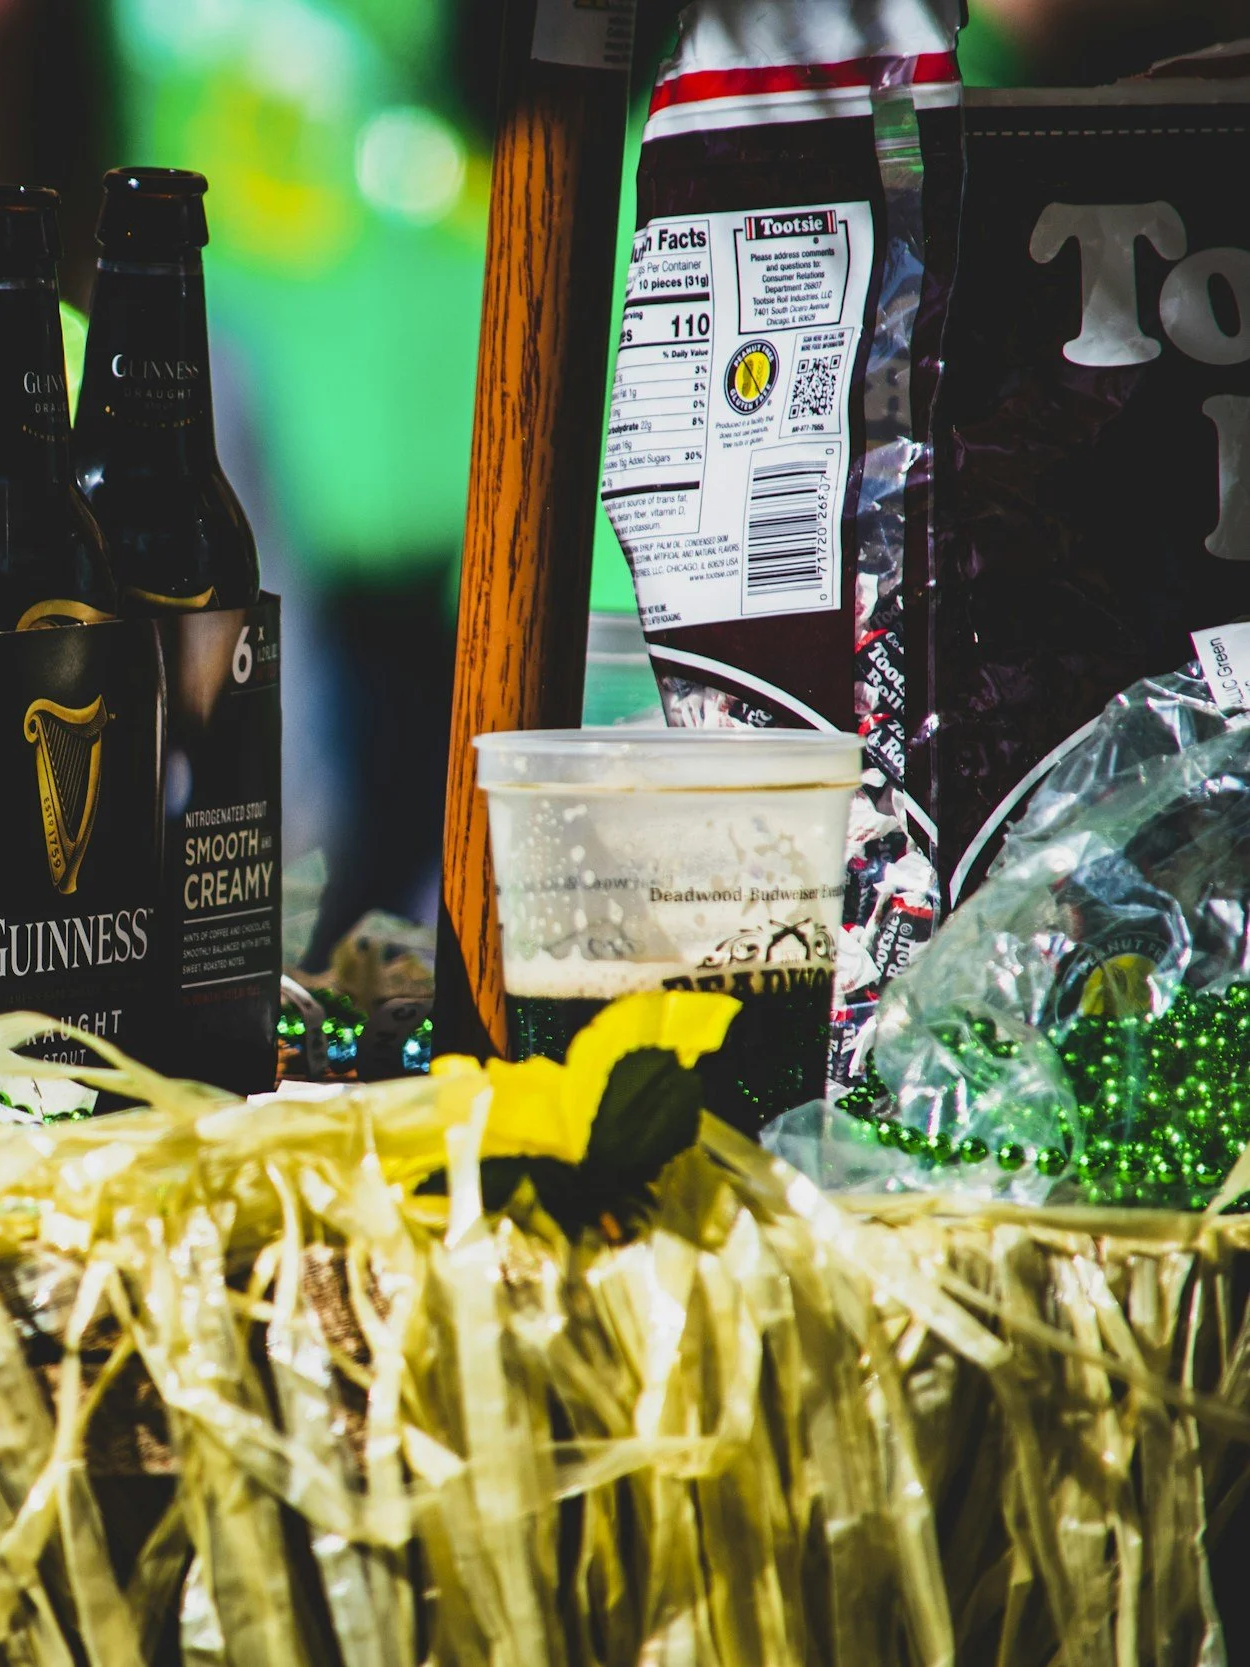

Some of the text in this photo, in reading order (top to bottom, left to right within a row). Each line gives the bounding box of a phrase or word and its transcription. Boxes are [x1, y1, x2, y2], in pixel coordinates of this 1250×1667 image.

[761, 216, 823, 235] Tootsie
[658, 227, 707, 250] Facts
[750, 248, 835, 262] Please address comments
[647, 262, 659, 273] Per
[662, 260, 701, 272] Container
[766, 260, 821, 272] and questions to:
[639, 274, 709, 291] 10 pieces (31g)
[762, 271, 825, 283] Consumer Relations
[765, 284, 802, 294] Department
[752, 297, 775, 306] Tootsie
[777, 295, 788, 303] Roll
[821, 291, 833, 299] LLC
[624, 312, 643, 320] erving
[754, 308, 769, 317] 7401
[771, 306, 788, 315] South
[671, 312, 710, 337] 110
[671, 350, 688, 358] Daily
[690, 348, 708, 356] Value
[695, 365, 707, 374] 3%
[694, 382, 706, 391] 5%
[693, 400, 705, 408] 0%
[647, 453, 671, 464] Sugars
[684, 451, 702, 460] 30%
[627, 499, 646, 508] source
[656, 495, 675, 504] trans
[651, 508, 676, 518] vitamin
[817, 527, 828, 574] 71720
[726, 557, 739, 567] USA
[1210, 637, 1232, 677] Green
[868, 641, 905, 697] Toot
[867, 667, 903, 709] Roll
[185, 801, 267, 828] NITROGENATED STOUT
[48, 829, 62, 868] 1759
[185, 828, 258, 866] SMOOTH
[184, 860, 273, 910] CREAMY
[650, 886, 742, 902] Deadwood
[750, 885, 818, 901] Budweiser
[183, 931, 200, 943] HINTS
[209, 927, 228, 940] COFFEE
[230, 925, 241, 936] AND
[212, 943, 241, 955] BALANCED
[876, 915, 900, 974] ootsie
[203, 959, 227, 971] ROASTED
[43, 1049, 86, 1065] STOUT
